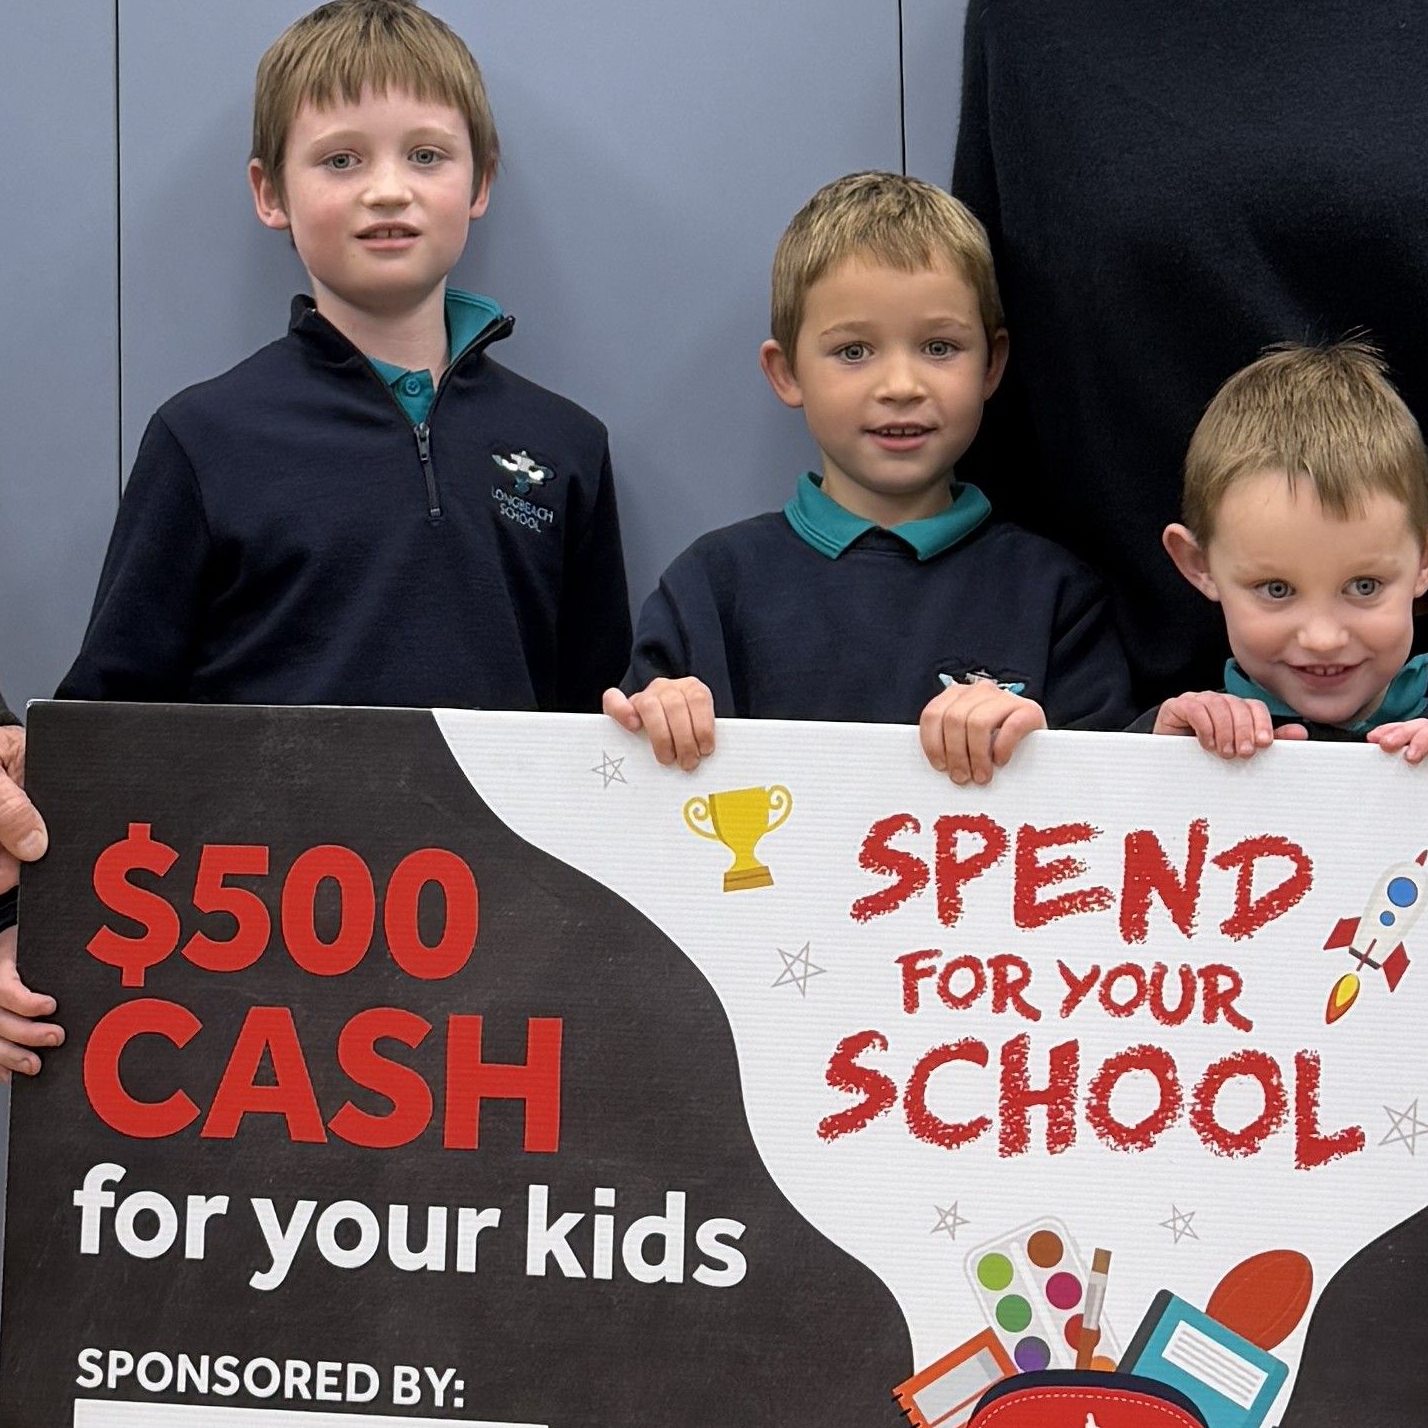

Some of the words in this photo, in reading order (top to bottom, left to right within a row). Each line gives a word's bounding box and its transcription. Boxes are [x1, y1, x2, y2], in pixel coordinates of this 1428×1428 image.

[87, 823, 479, 987] $500
[849, 812, 1314, 945] SPEND
[894, 949, 1042, 1022] FOR
[1057, 959, 1254, 1032] YOUR
[83, 998, 563, 1152] CASH
[816, 1030, 1366, 1171] SCHOOL
[74, 1162, 228, 1259] for
[249, 1187, 500, 1291] your
[526, 1184, 748, 1287] kids
[75, 1348, 380, 1402] SPONSORED
[393, 1366, 465, 1408] BY:
